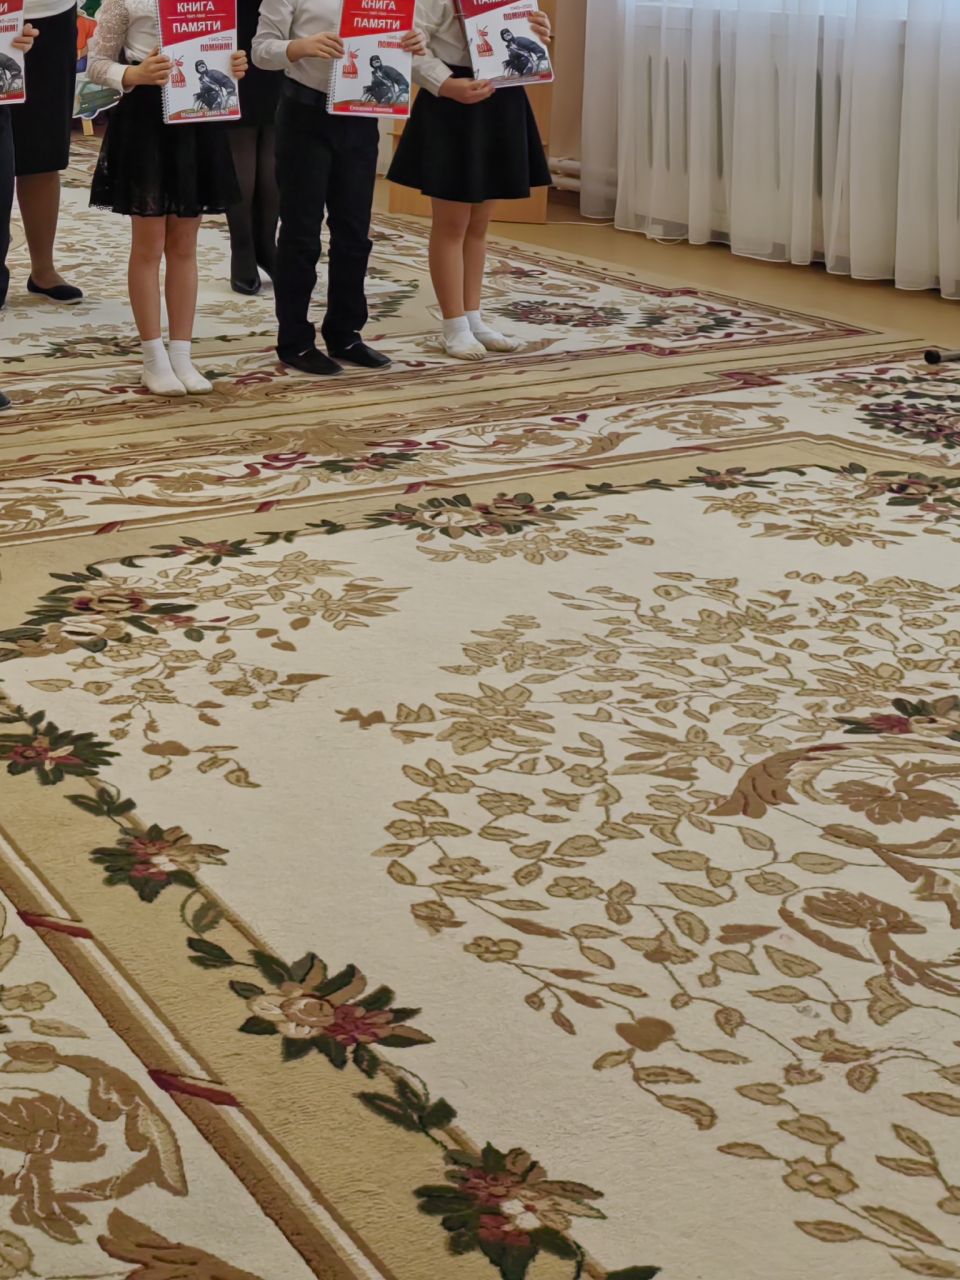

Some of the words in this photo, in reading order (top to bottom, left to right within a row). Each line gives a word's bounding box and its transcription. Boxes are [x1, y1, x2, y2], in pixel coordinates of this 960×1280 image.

[177, 1, 214, 13] КНИГА
[172, 20, 221, 34] ПАМЯТИ
[354, 17, 400, 30] ПАМЯТИ
[200, 42, 232, 52] ПОМНИМ!
